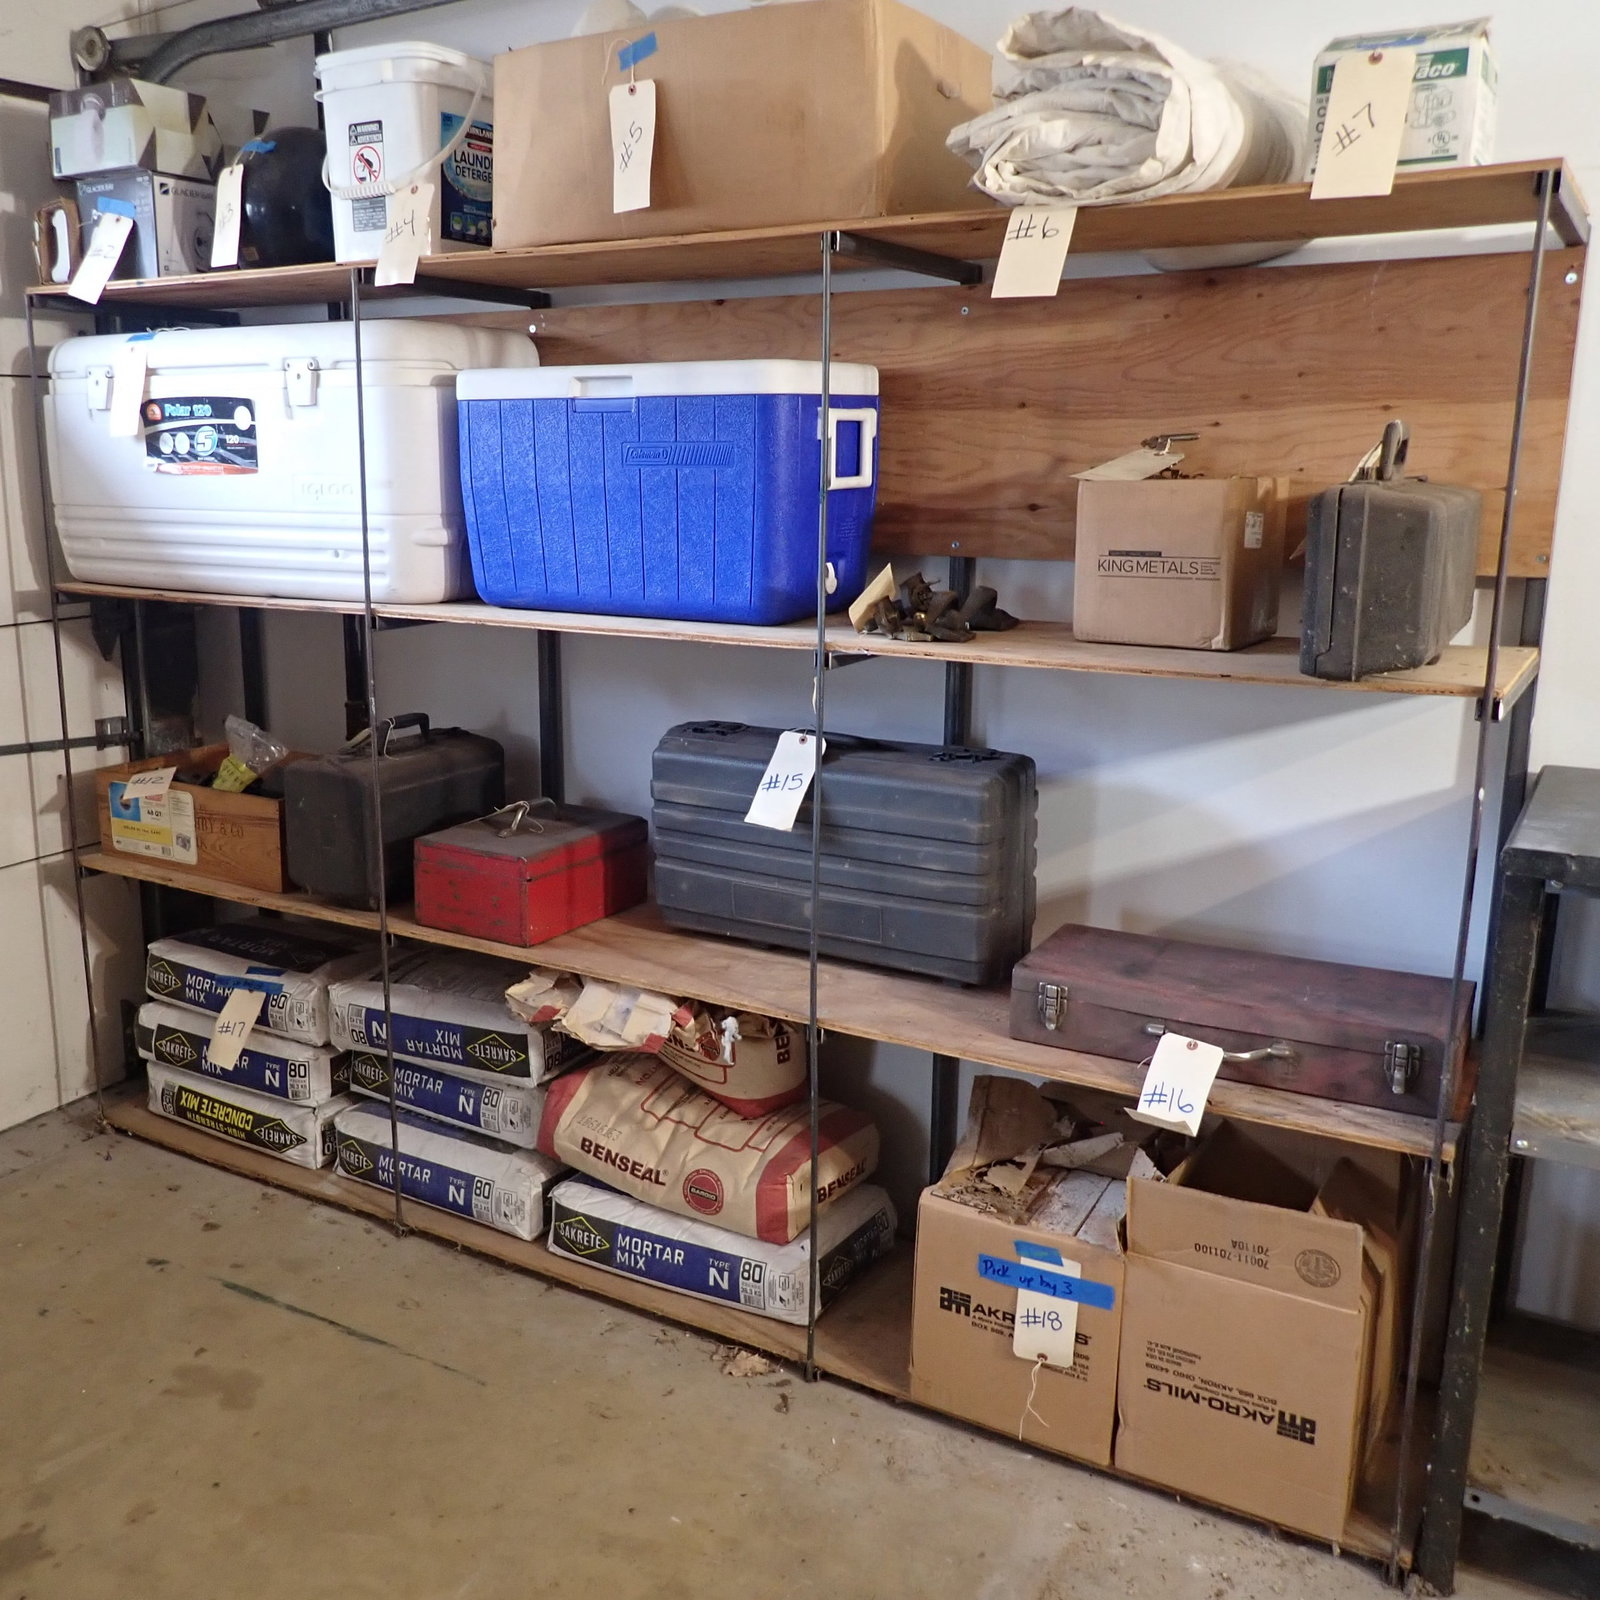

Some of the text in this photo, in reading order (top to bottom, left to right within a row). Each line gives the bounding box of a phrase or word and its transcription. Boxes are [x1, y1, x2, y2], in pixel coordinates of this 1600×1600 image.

[1330, 101, 1376, 157] #7
[619, 121, 643, 173] #5
[384, 209, 416, 244] #4
[1007, 213, 1060, 241] #6
[164, 403, 212, 417] Polar 120
[225, 435, 240, 444] 120
[761, 773, 804, 792] #15
[152, 969, 177, 987] AKRETE
[185, 987, 206, 1004] MIX
[270, 993, 287, 1010] 80
[217, 1020, 246, 1037] #17
[351, 1029, 367, 1045] 80
[371, 1020, 387, 1040] N
[435, 1029, 460, 1044] MIX
[161, 1039, 193, 1059] SAKRETE
[405, 1039, 463, 1060] MORTAR
[474, 1043, 517, 1062] SAKRETE
[202, 1058, 223, 1076] MIX
[288, 1063, 307, 1078] 80
[354, 1061, 384, 1082] SAKRETE
[265, 1072, 280, 1088] N
[394, 1067, 443, 1094] MORTAR
[393, 1082, 415, 1100] MIX
[460, 1087, 475, 1097] TYPE
[482, 1089, 500, 1108] 80
[1143, 1081, 1194, 1114] #16
[180, 1090, 253, 1131] CONCRETE MIX
[458, 1095, 474, 1115] N
[260, 1127, 298, 1145] SAKRETE
[580, 1136, 667, 1187] BENSEAL
[379, 1170, 395, 1185] MI
[449, 1177, 466, 1187] TYPE
[817, 1160, 866, 1204] BENSEAL
[449, 1185, 465, 1206] N
[474, 1179, 492, 1199] 80
[559, 1222, 603, 1249] SAKRETE
[617, 1233, 685, 1266] MORTAR
[616, 1249, 646, 1272] MIX
[708, 1258, 731, 1271] TYPE
[708, 1266, 729, 1290] N
[741, 1261, 763, 1284] 80
[982, 1259, 1009, 1278] Pick
[1019, 1275, 1034, 1288] up
[1062, 1281, 1073, 1295] 3
[1020, 1307, 1063, 1331] #18
[1172, 1368, 1196, 1381] OHIO
[1146, 1377, 1276, 1425] AKRO-MILS
[1257, 1394, 1277, 1405] BOX
